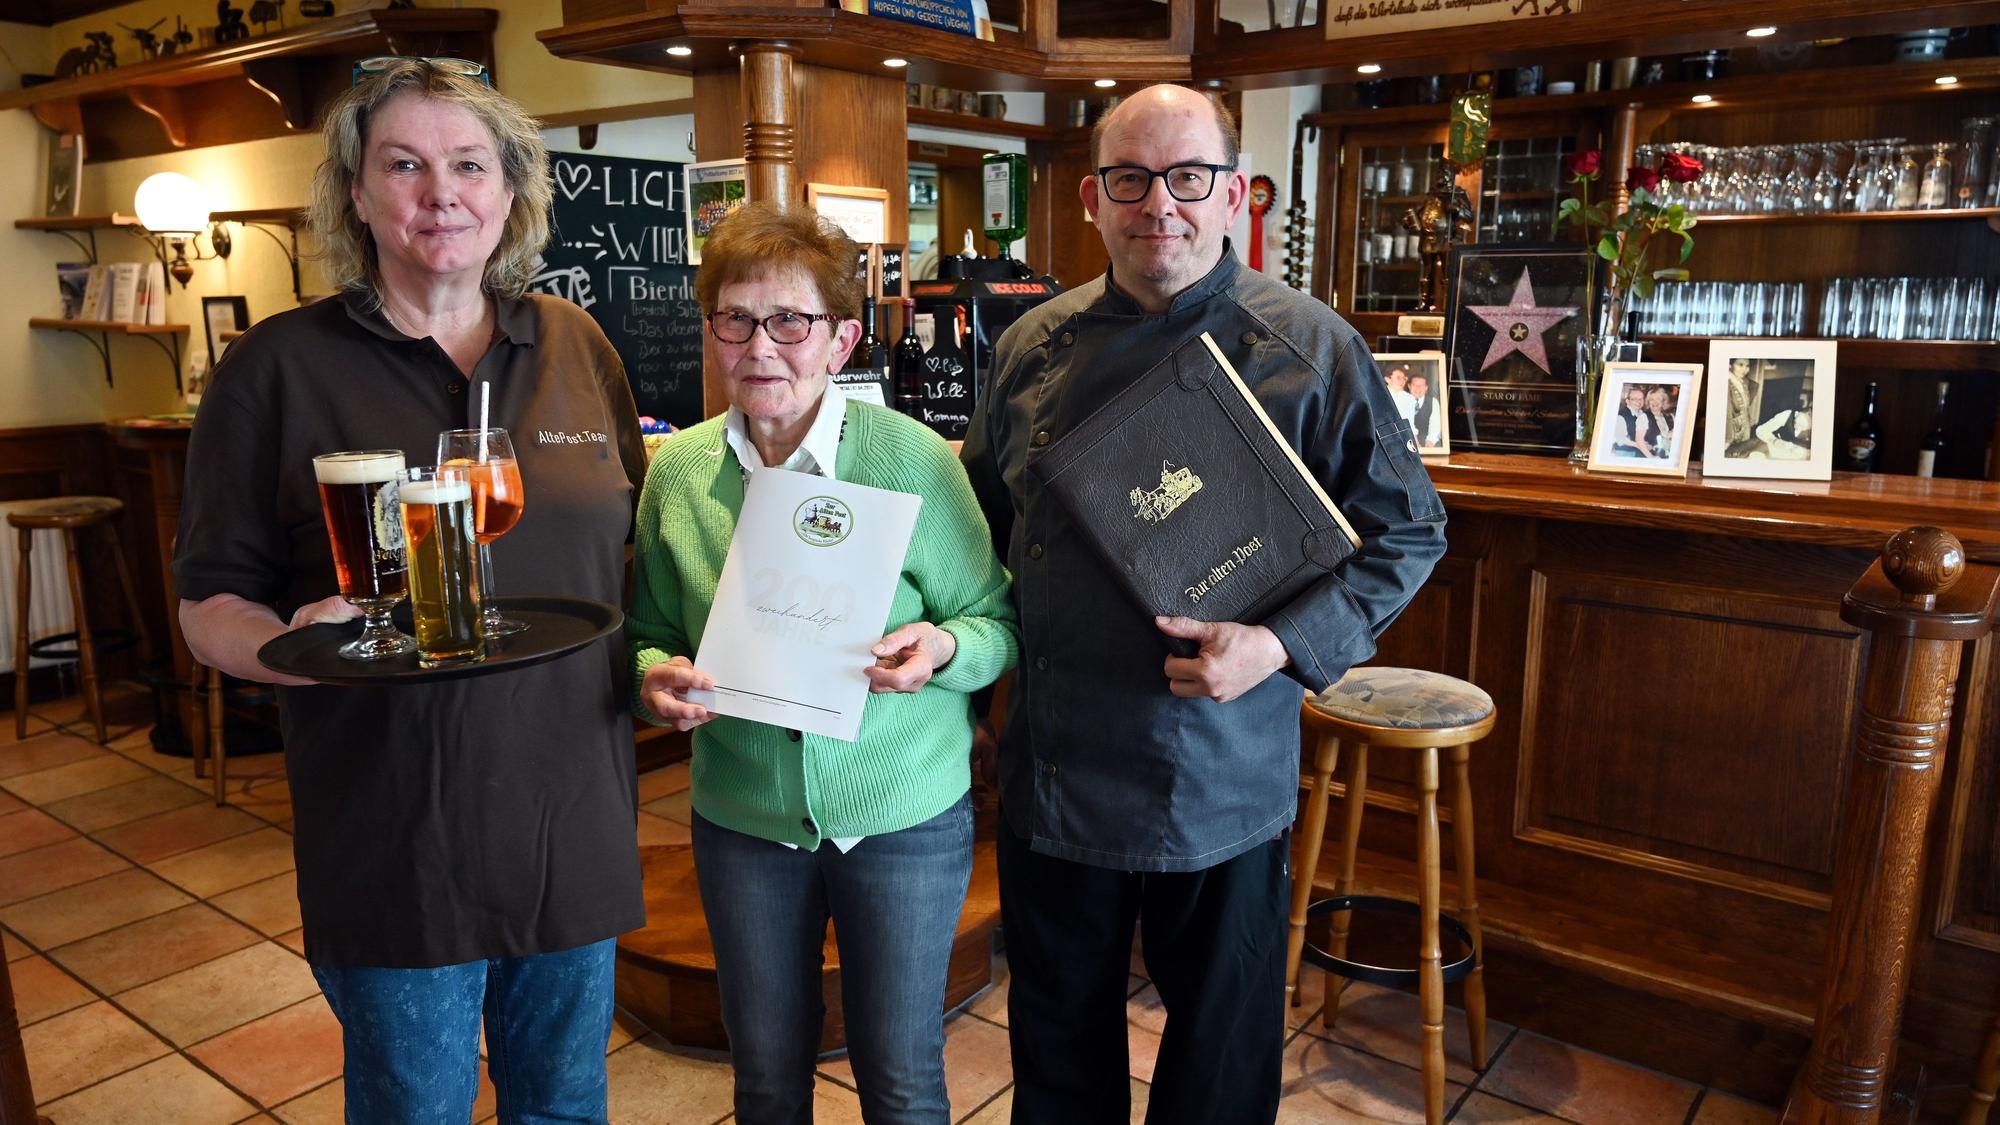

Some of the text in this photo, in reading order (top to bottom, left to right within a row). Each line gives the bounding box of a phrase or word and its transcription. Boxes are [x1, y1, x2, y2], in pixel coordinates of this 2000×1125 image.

[874, 1, 901, 14] HOPFEN
[902, 7, 915, 17] UND
[917, 11, 943, 24] GERSTE
[1483, 391, 1541, 401] STAR OF FAME
[1185, 578, 1210, 604] Zur
[1232, 536, 1263, 566] Post
